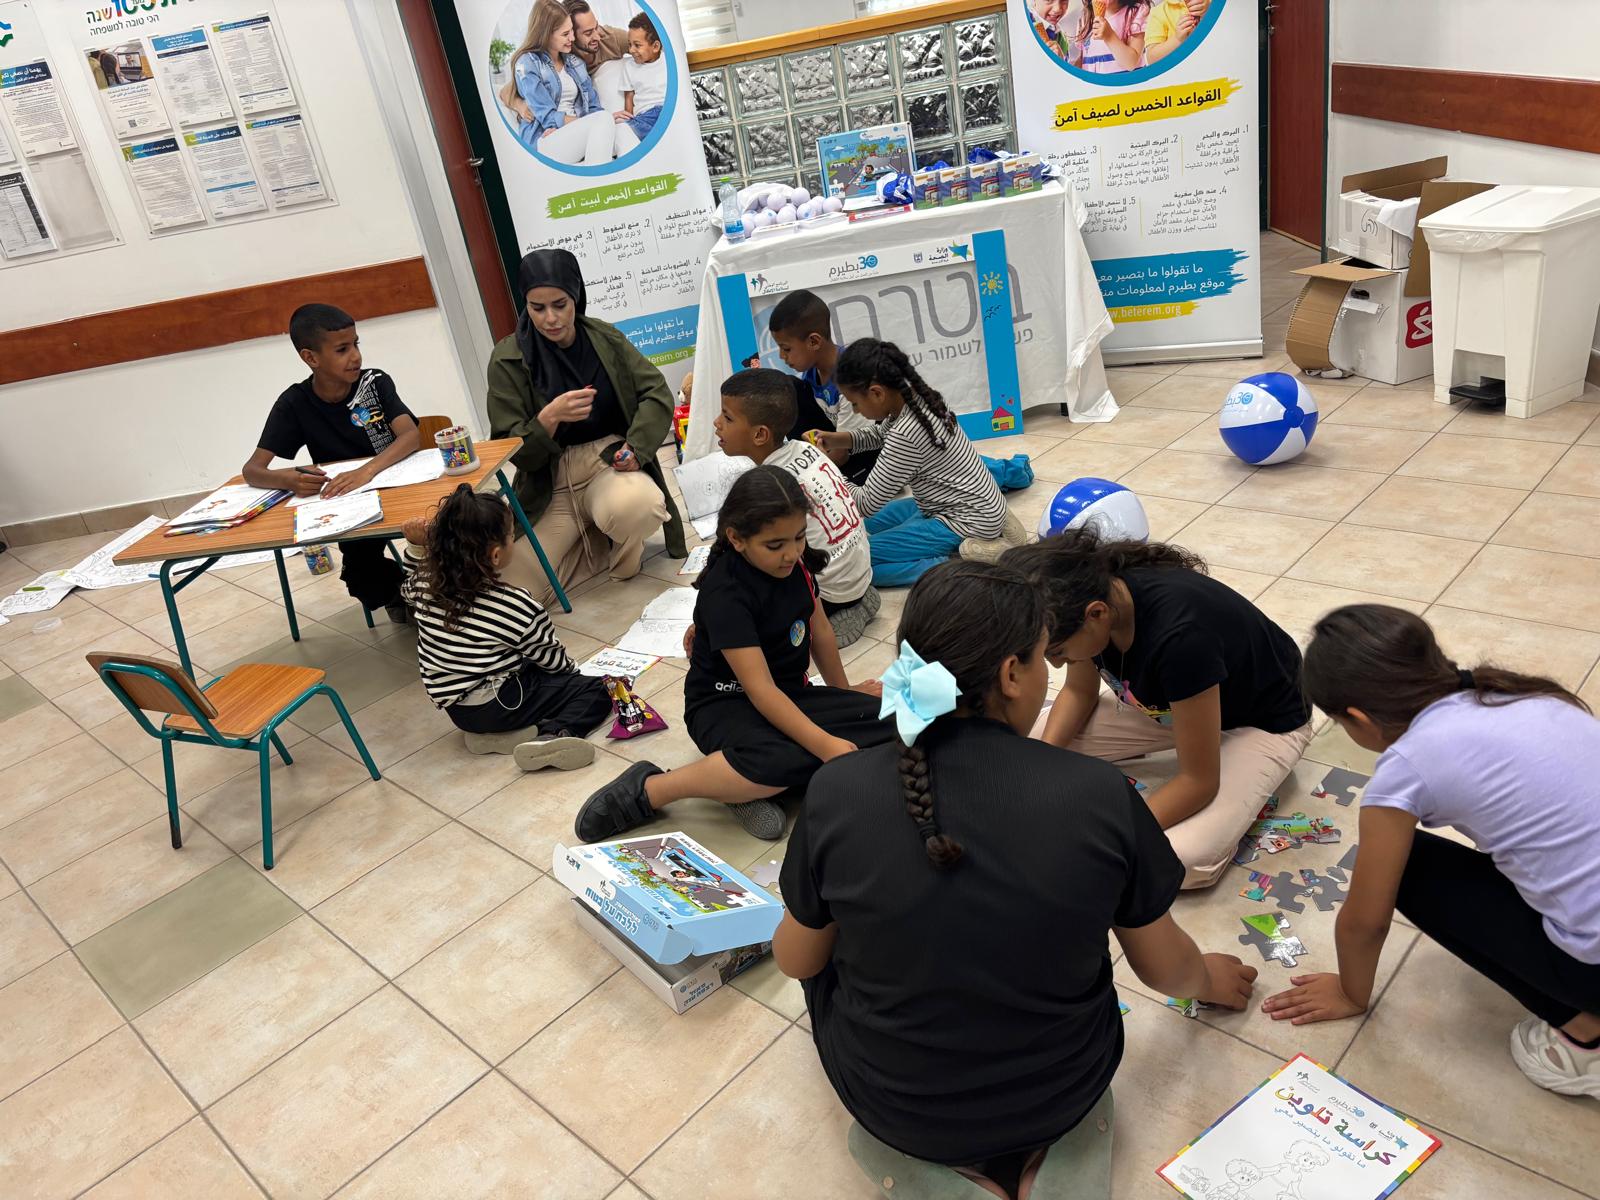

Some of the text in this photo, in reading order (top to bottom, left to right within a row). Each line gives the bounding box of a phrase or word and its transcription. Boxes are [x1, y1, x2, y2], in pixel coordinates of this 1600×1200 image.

[86, 7, 112, 23] שנה
[90, 14, 160, 36] הכי טובה למשפחה
[1054, 88, 1222, 127] القواعد الخمس لصيف آمن
[558, 179, 668, 213] القواعد الخمس لبيت آمن
[1115, 270, 1145, 283] بتصير
[1148, 267, 1158, 278] ما
[1161, 265, 1190, 279] تقولوا
[1192, 263, 1204, 274] ما
[1117, 282, 1166, 297] لمعلومات
[1168, 280, 1197, 296] بطيرم
[1200, 278, 1225, 293] موقع
[644, 316, 684, 333] ما تقولوا ما
[656, 328, 694, 344] موقع بطيرم
[929, 339, 982, 362] לשמור
[604, 899, 615, 916] על
[615, 911, 639, 935] ללכת
[1274, 1106, 1294, 1119] معي
[1275, 1086, 1397, 1166] كراسة تلوين
[1293, 1120, 1321, 1139] بتصير
[1322, 1136, 1331, 1146] ما
[1356, 1159, 1366, 1169] ما
